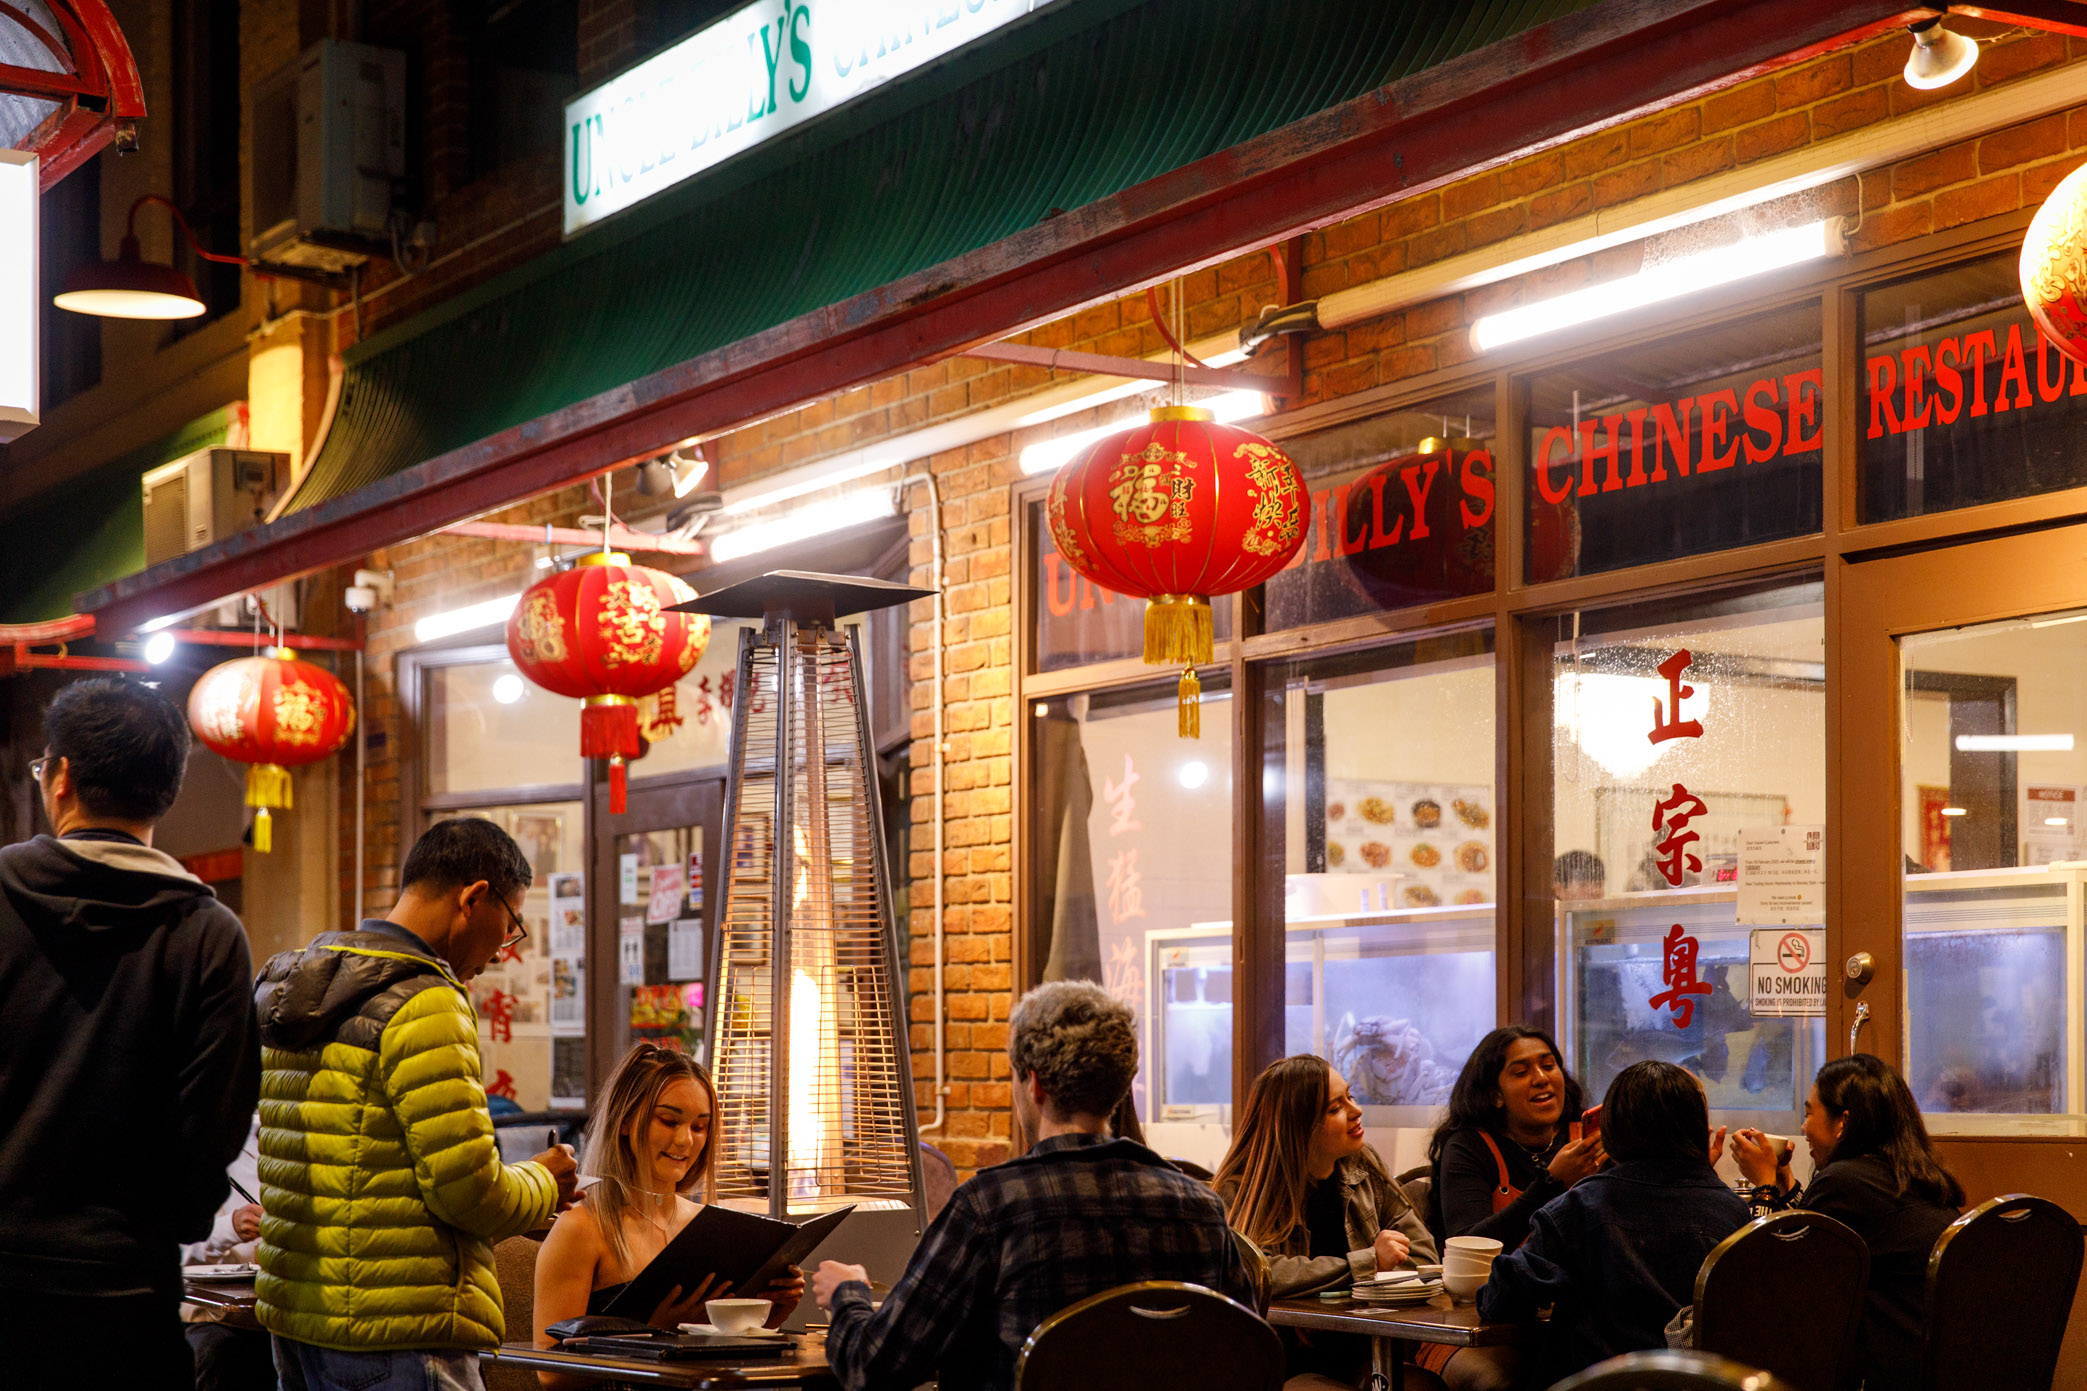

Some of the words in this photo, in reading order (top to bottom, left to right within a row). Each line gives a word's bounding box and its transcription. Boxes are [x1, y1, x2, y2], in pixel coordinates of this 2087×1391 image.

[1282, 447, 1495, 571] ILLY'S
[1536, 367, 1824, 505] CHINESE
[1103, 753, 1146, 1094] 生猛海
[1755, 997, 1776, 1007] SMOKING
[1783, 998, 1812, 1007] PROHIBITED
[1757, 976, 1772, 994] NO
